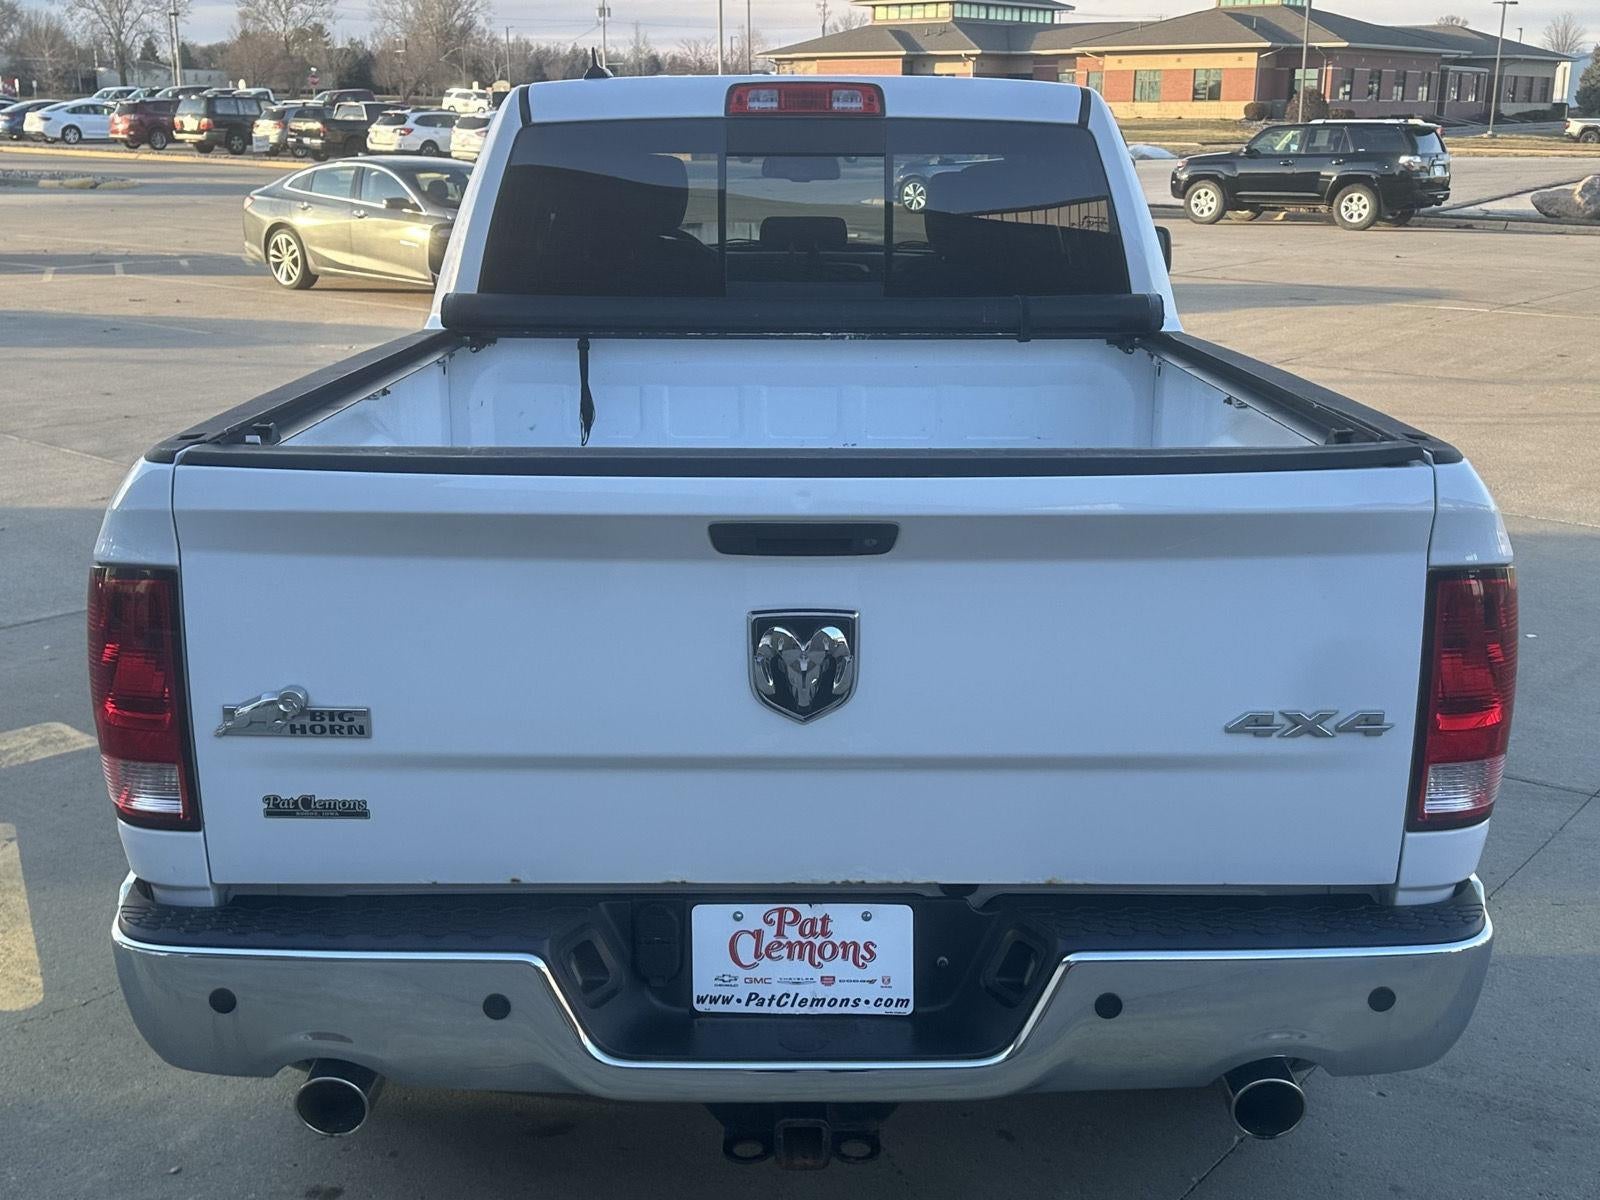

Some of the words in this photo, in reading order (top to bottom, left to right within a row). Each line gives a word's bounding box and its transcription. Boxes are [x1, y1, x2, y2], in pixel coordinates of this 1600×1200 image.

[309, 710, 355, 723] BIG
[1224, 710, 1395, 737] 4X4
[289, 723, 366, 736] HORN
[262, 795, 297, 809] Pat
[297, 794, 368, 812] Clemons
[762, 906, 833, 940] Pat
[728, 928, 878, 971] Clemons
[743, 976, 772, 985] GMC
